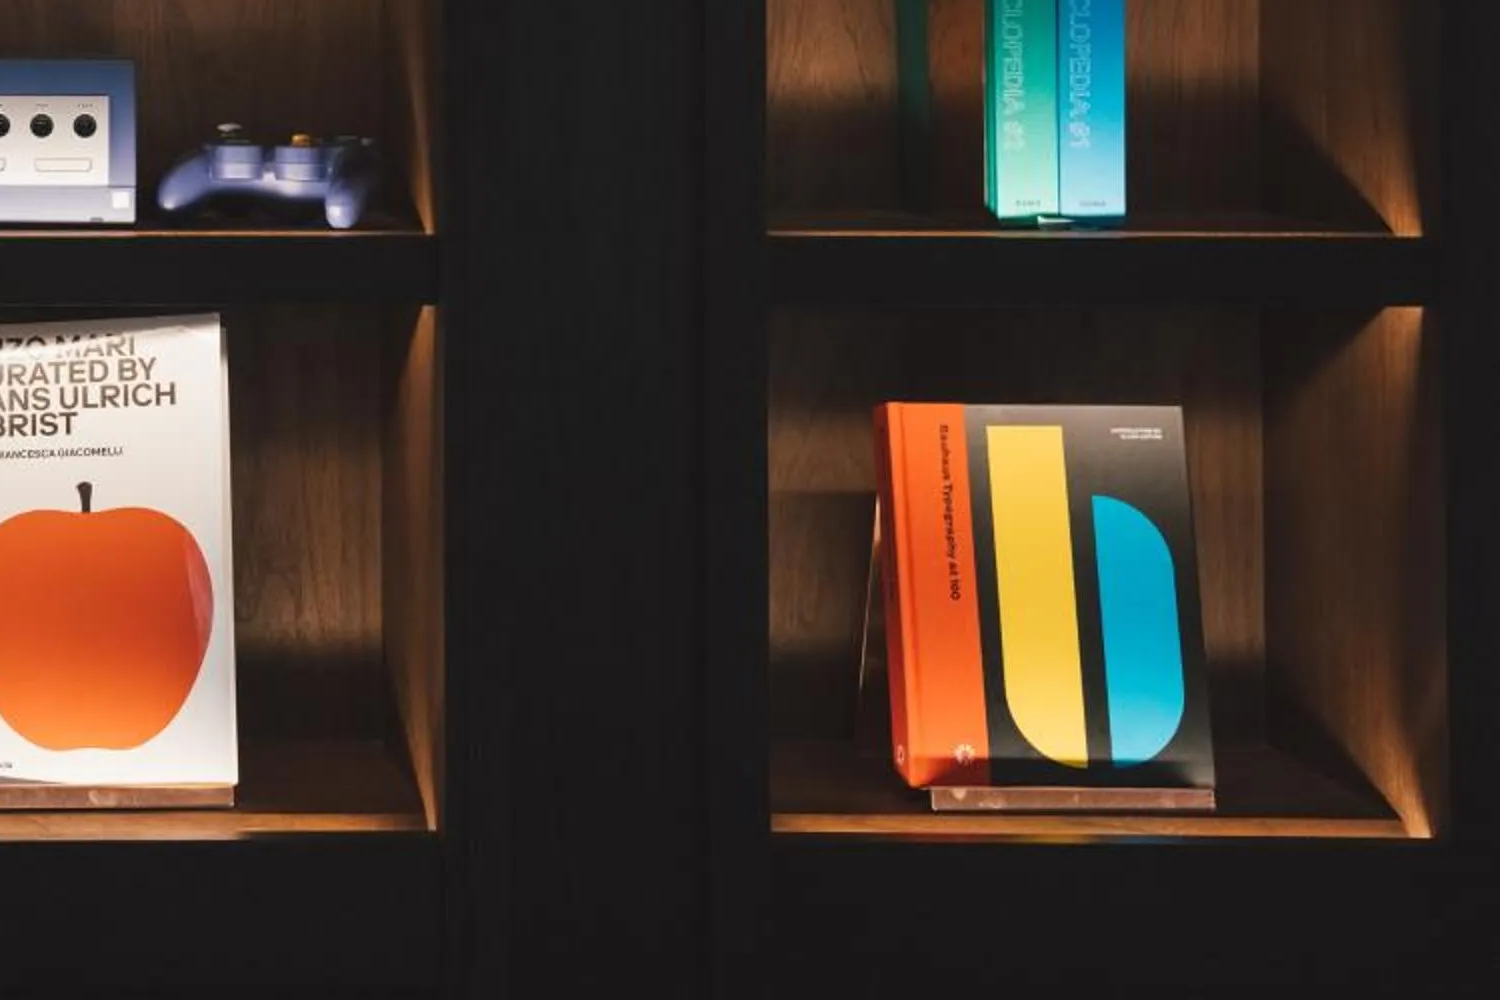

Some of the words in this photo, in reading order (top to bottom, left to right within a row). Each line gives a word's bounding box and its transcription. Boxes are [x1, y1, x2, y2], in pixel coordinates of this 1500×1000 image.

[55, 332, 137, 359] MARI
[118, 356, 157, 381] BY
[59, 381, 177, 409] ULRICH
